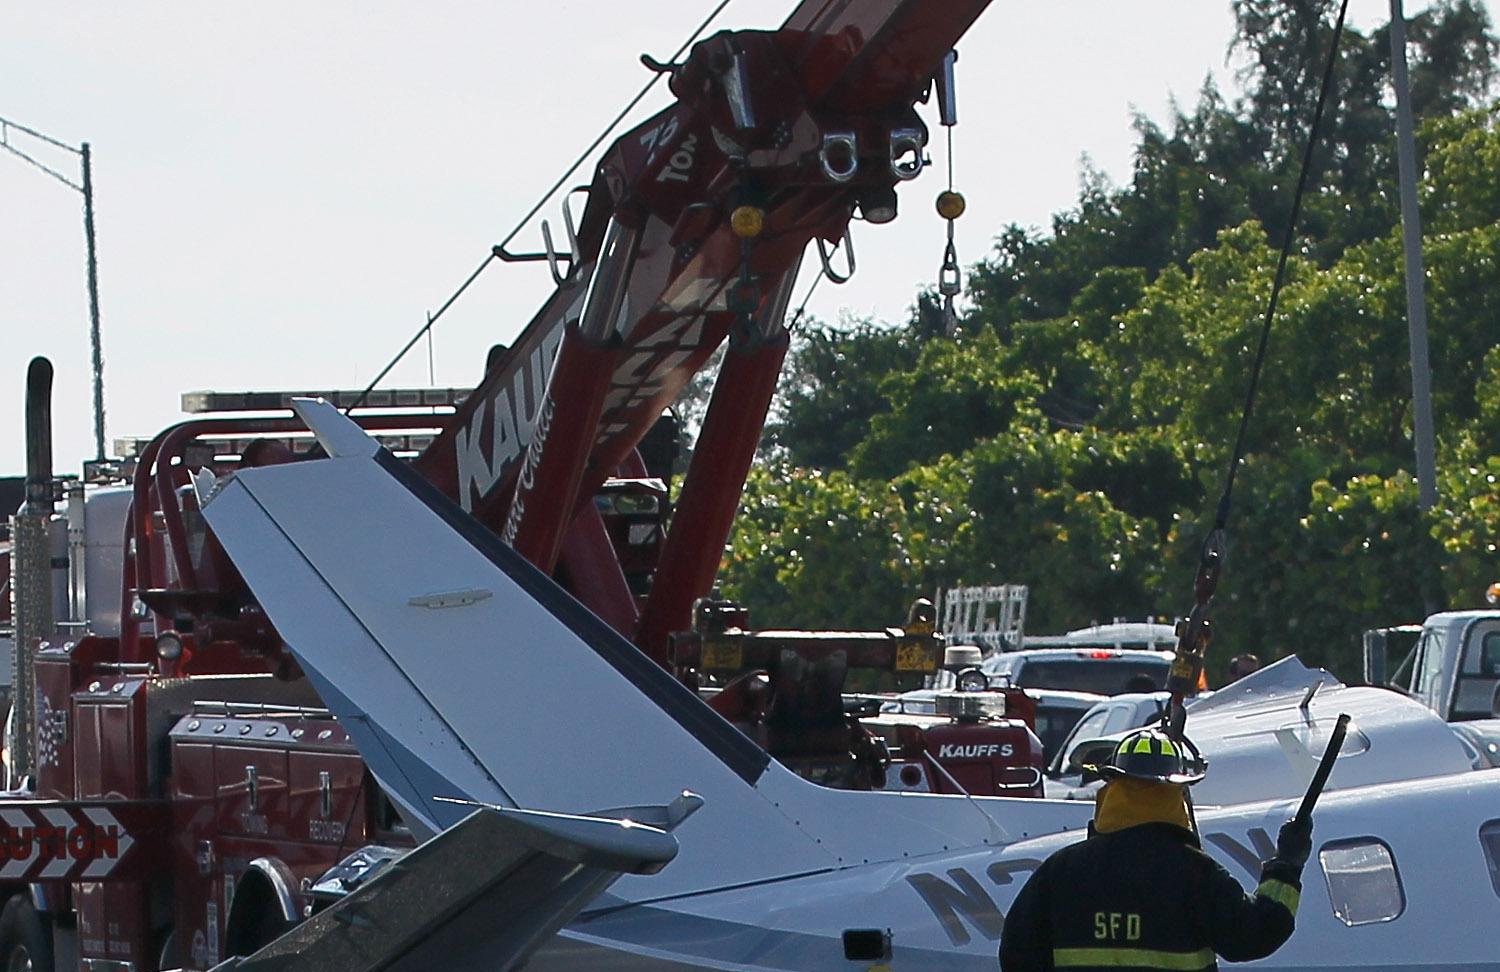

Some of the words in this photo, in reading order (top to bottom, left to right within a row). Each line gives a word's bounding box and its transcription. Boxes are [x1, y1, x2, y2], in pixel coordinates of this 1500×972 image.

[656, 133, 698, 182] TON
[456, 286, 586, 515] KAUF
[1094, 912, 1141, 940] SFD
